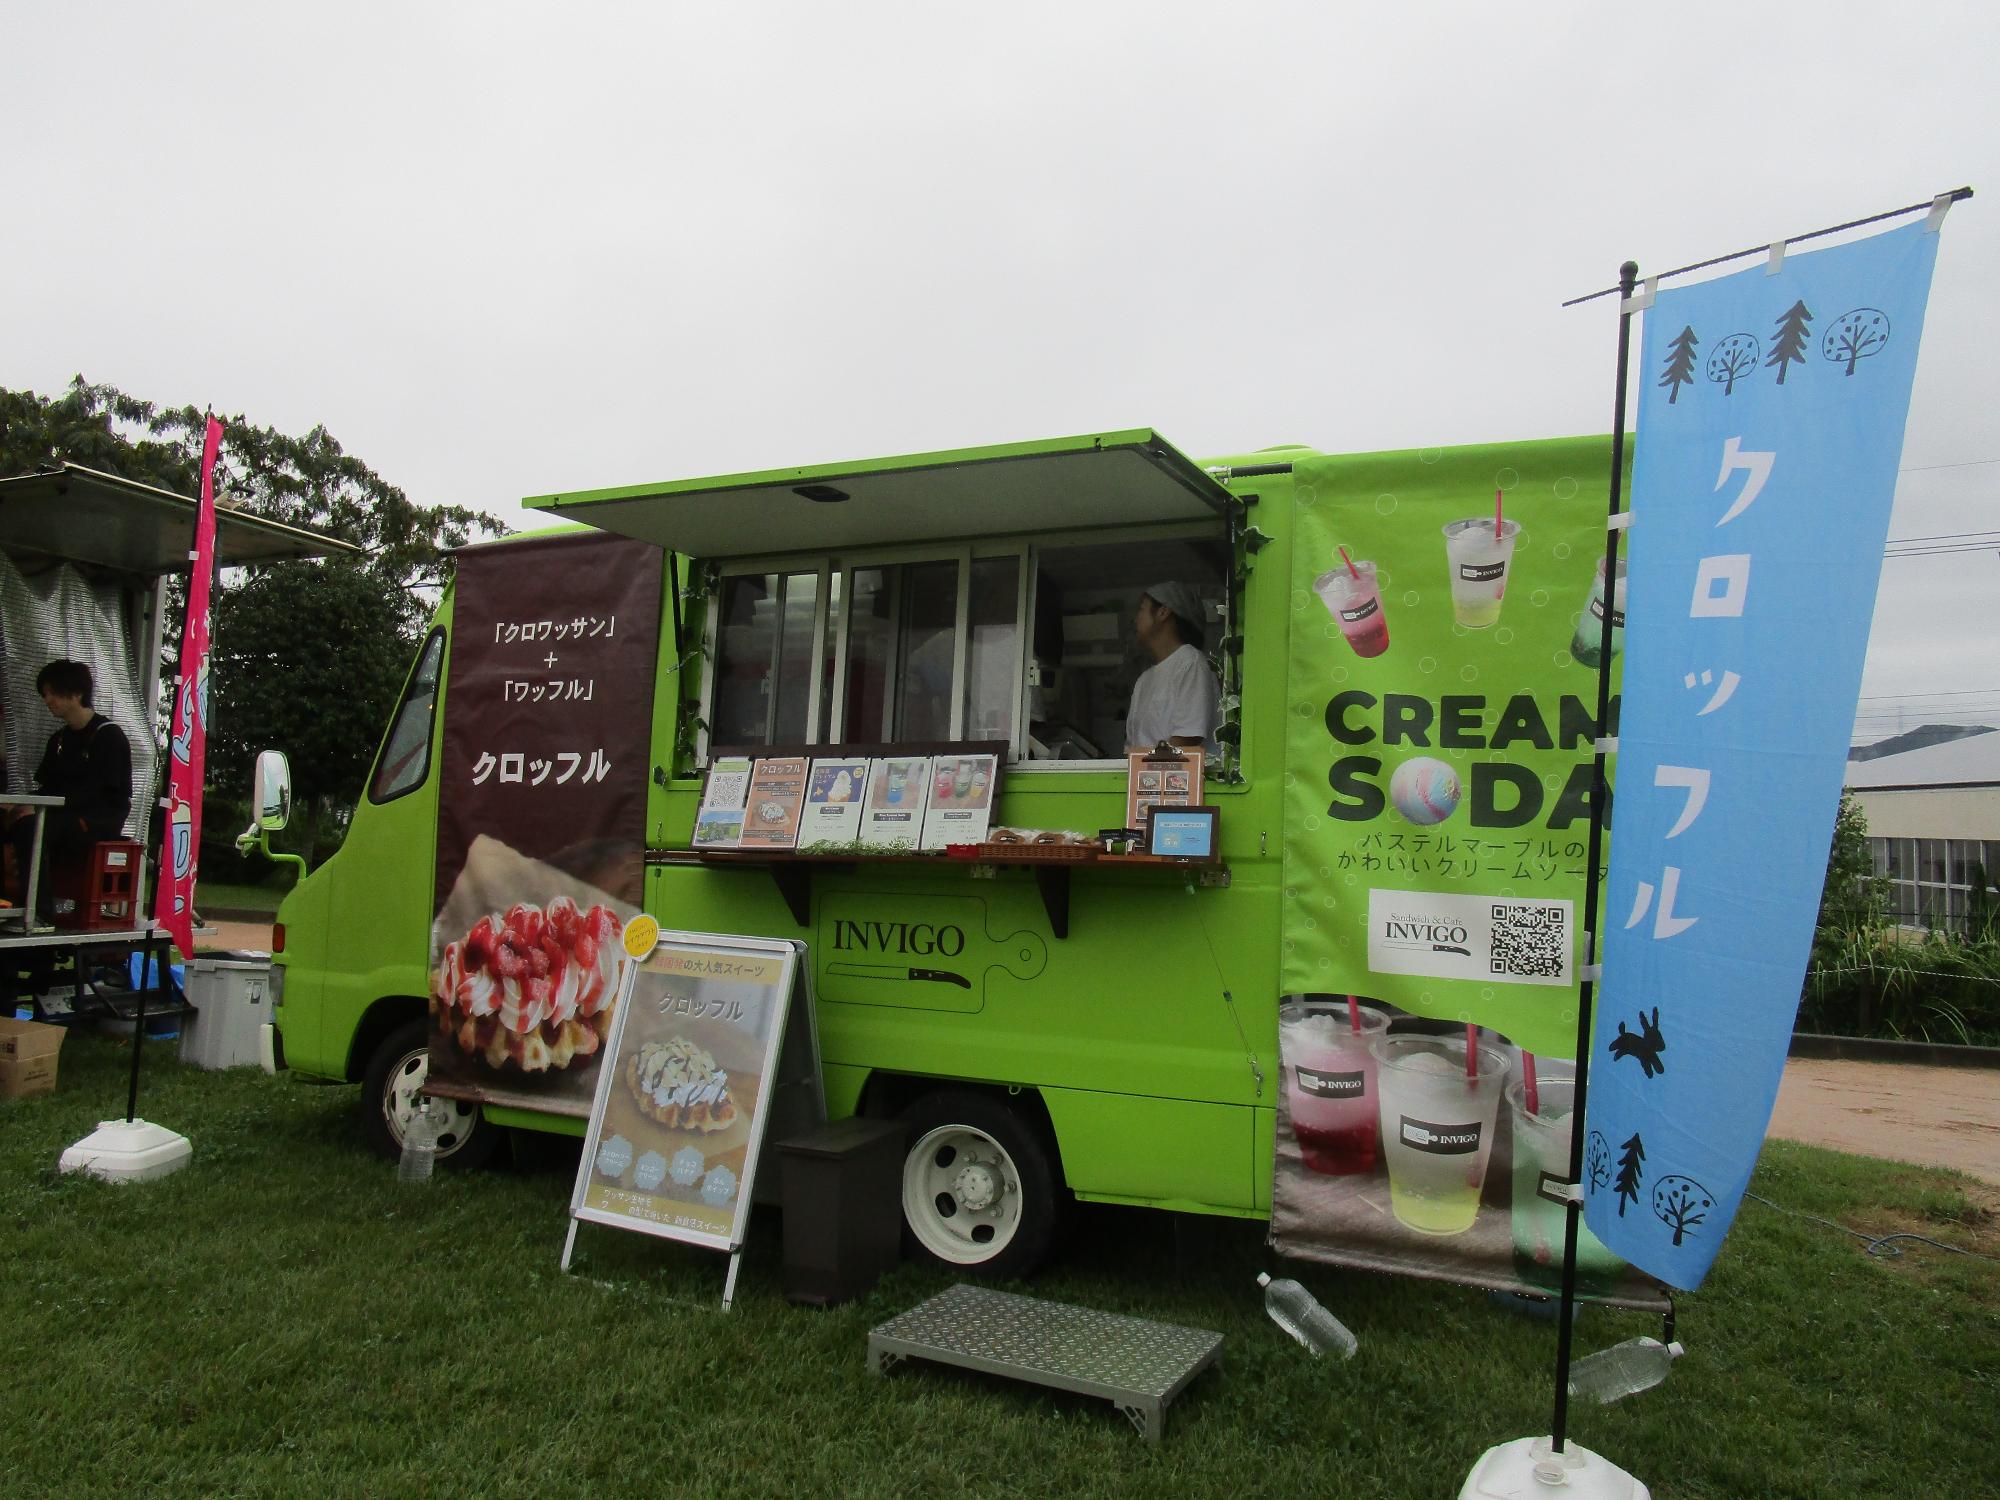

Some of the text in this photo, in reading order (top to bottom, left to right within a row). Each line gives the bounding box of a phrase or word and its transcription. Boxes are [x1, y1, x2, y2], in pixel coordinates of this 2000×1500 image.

[495, 615, 616, 644] 「クロワッサン」
[504, 679, 594, 702] 「ワッフル」
[1623, 435, 1777, 940] クロッフル
[1324, 689, 1621, 750] CREAM
[471, 748, 612, 786] クロッフル
[760, 764, 801, 775] クロッフル
[1362, 833, 1585, 859] パステルマーブルの
[1391, 912, 1463, 926] Sandwich & Cafe
[832, 919, 966, 957] INVIGO
[1385, 921, 1468, 944] INVIGO
[658, 990, 744, 1022] クロッフル
[1327, 1079, 1362, 1090] INVIGO
[1440, 1133, 1477, 1145] INVIGO
